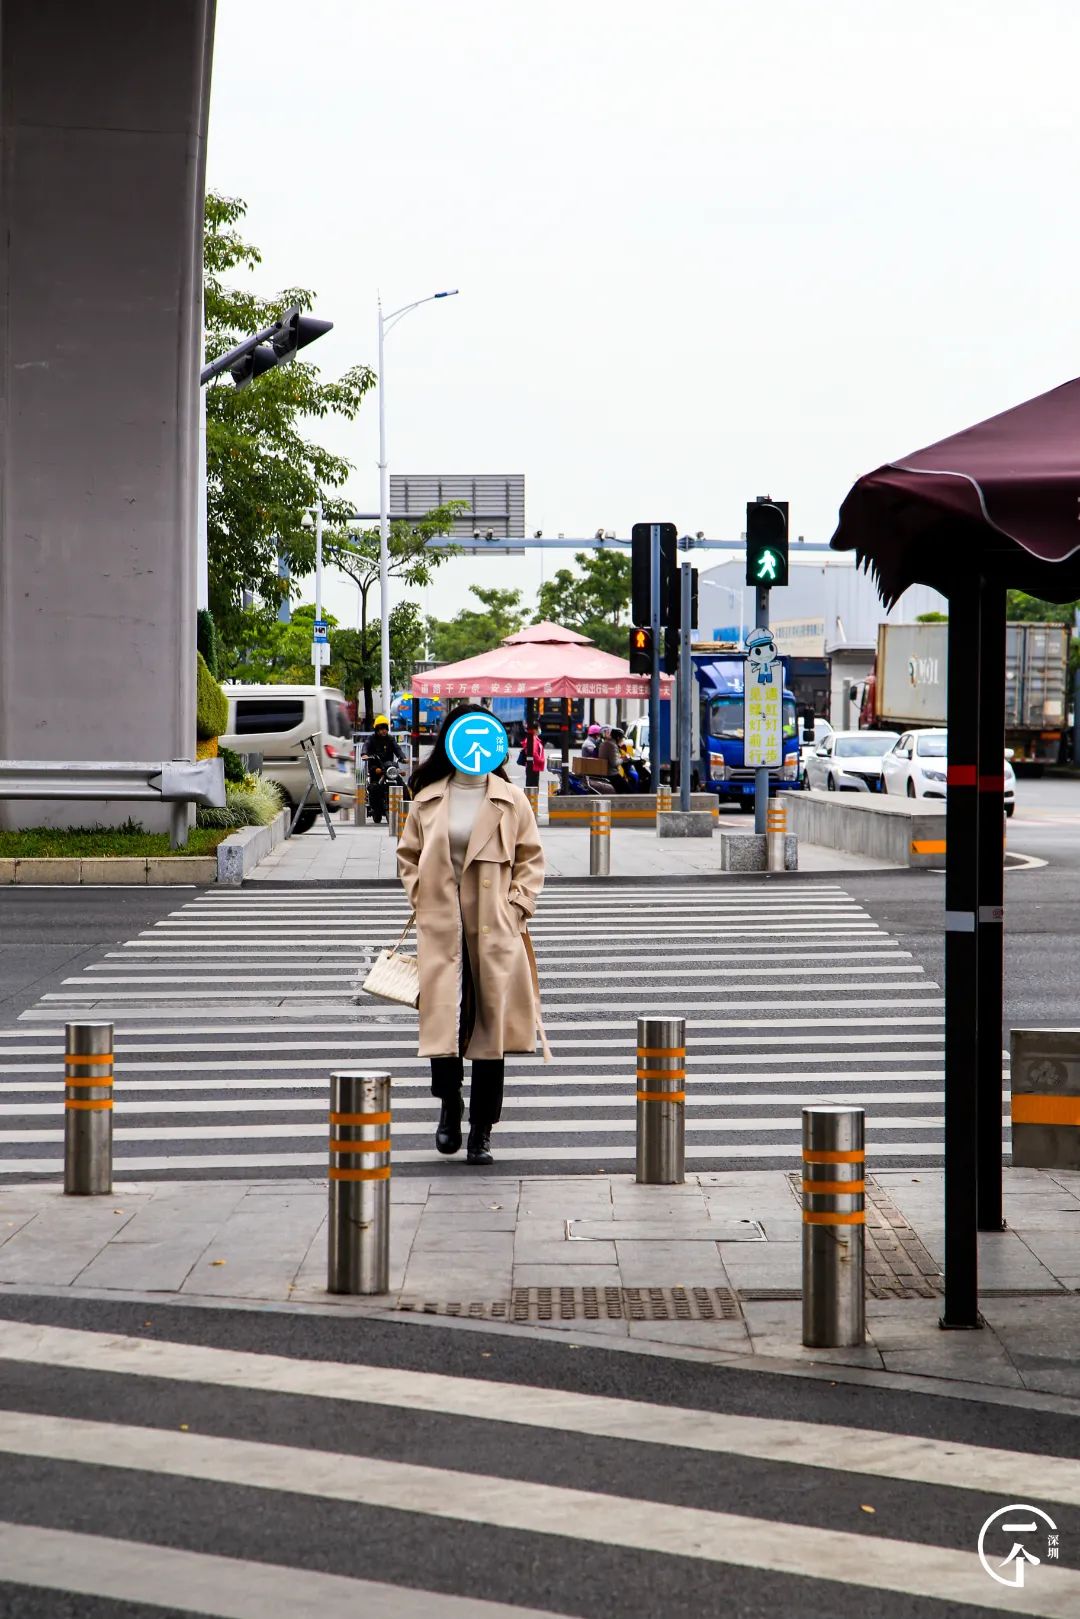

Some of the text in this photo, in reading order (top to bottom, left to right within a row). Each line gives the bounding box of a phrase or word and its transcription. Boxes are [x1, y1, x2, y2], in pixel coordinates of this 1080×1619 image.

[490, 681, 553, 695] 安全第一条
